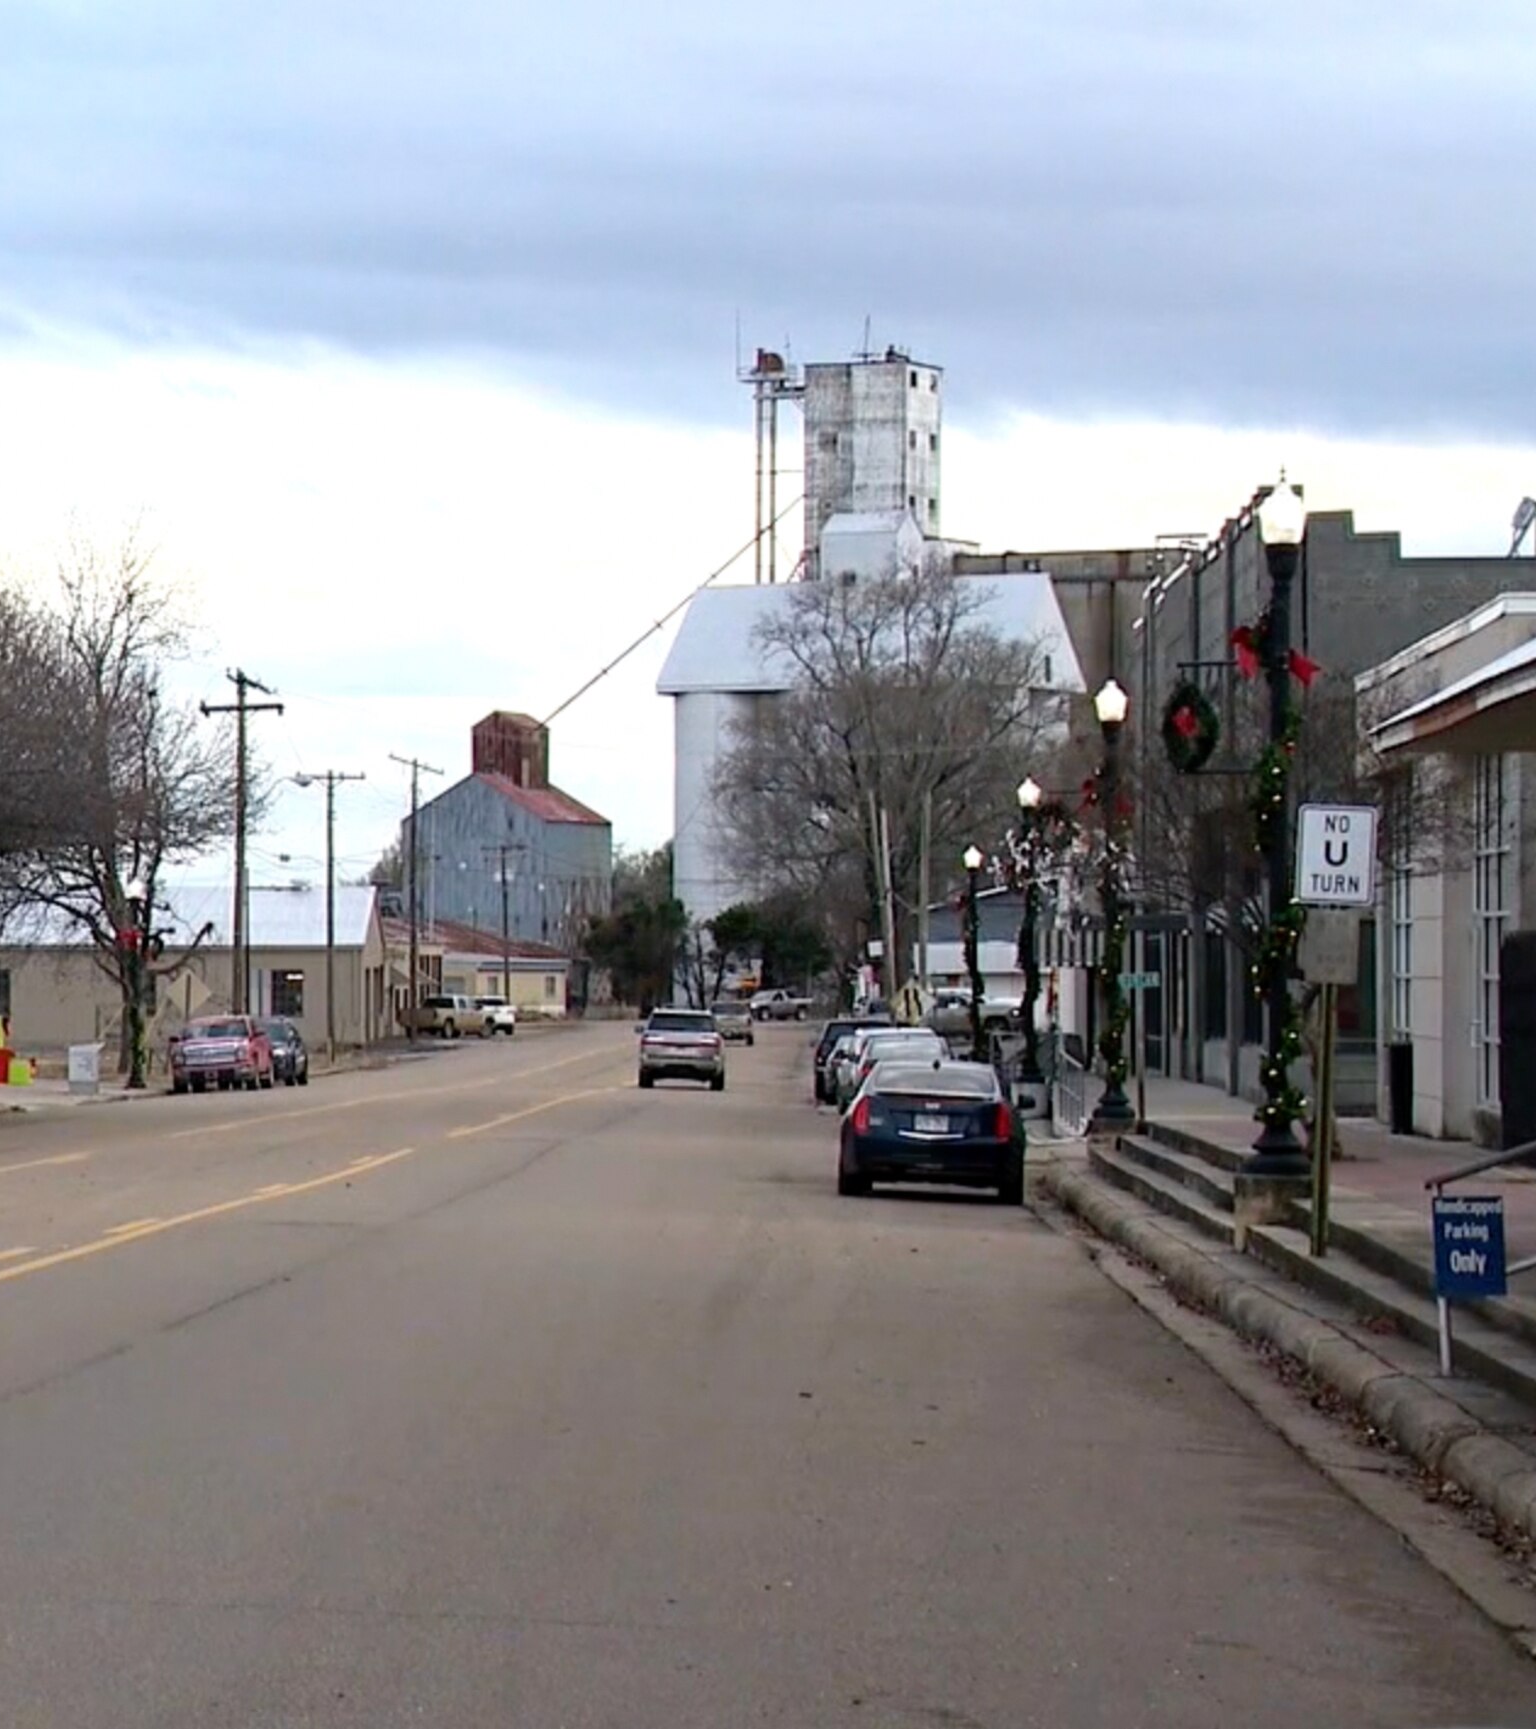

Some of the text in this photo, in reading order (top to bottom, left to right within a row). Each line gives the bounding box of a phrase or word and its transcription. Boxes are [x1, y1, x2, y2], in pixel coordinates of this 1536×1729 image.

[1324, 815, 1351, 834] NO
[1325, 840, 1348, 867] U
[1311, 873, 1360, 894] TURN
[1444, 1221, 1489, 1243] Parking
[1449, 1249, 1487, 1276] Only
